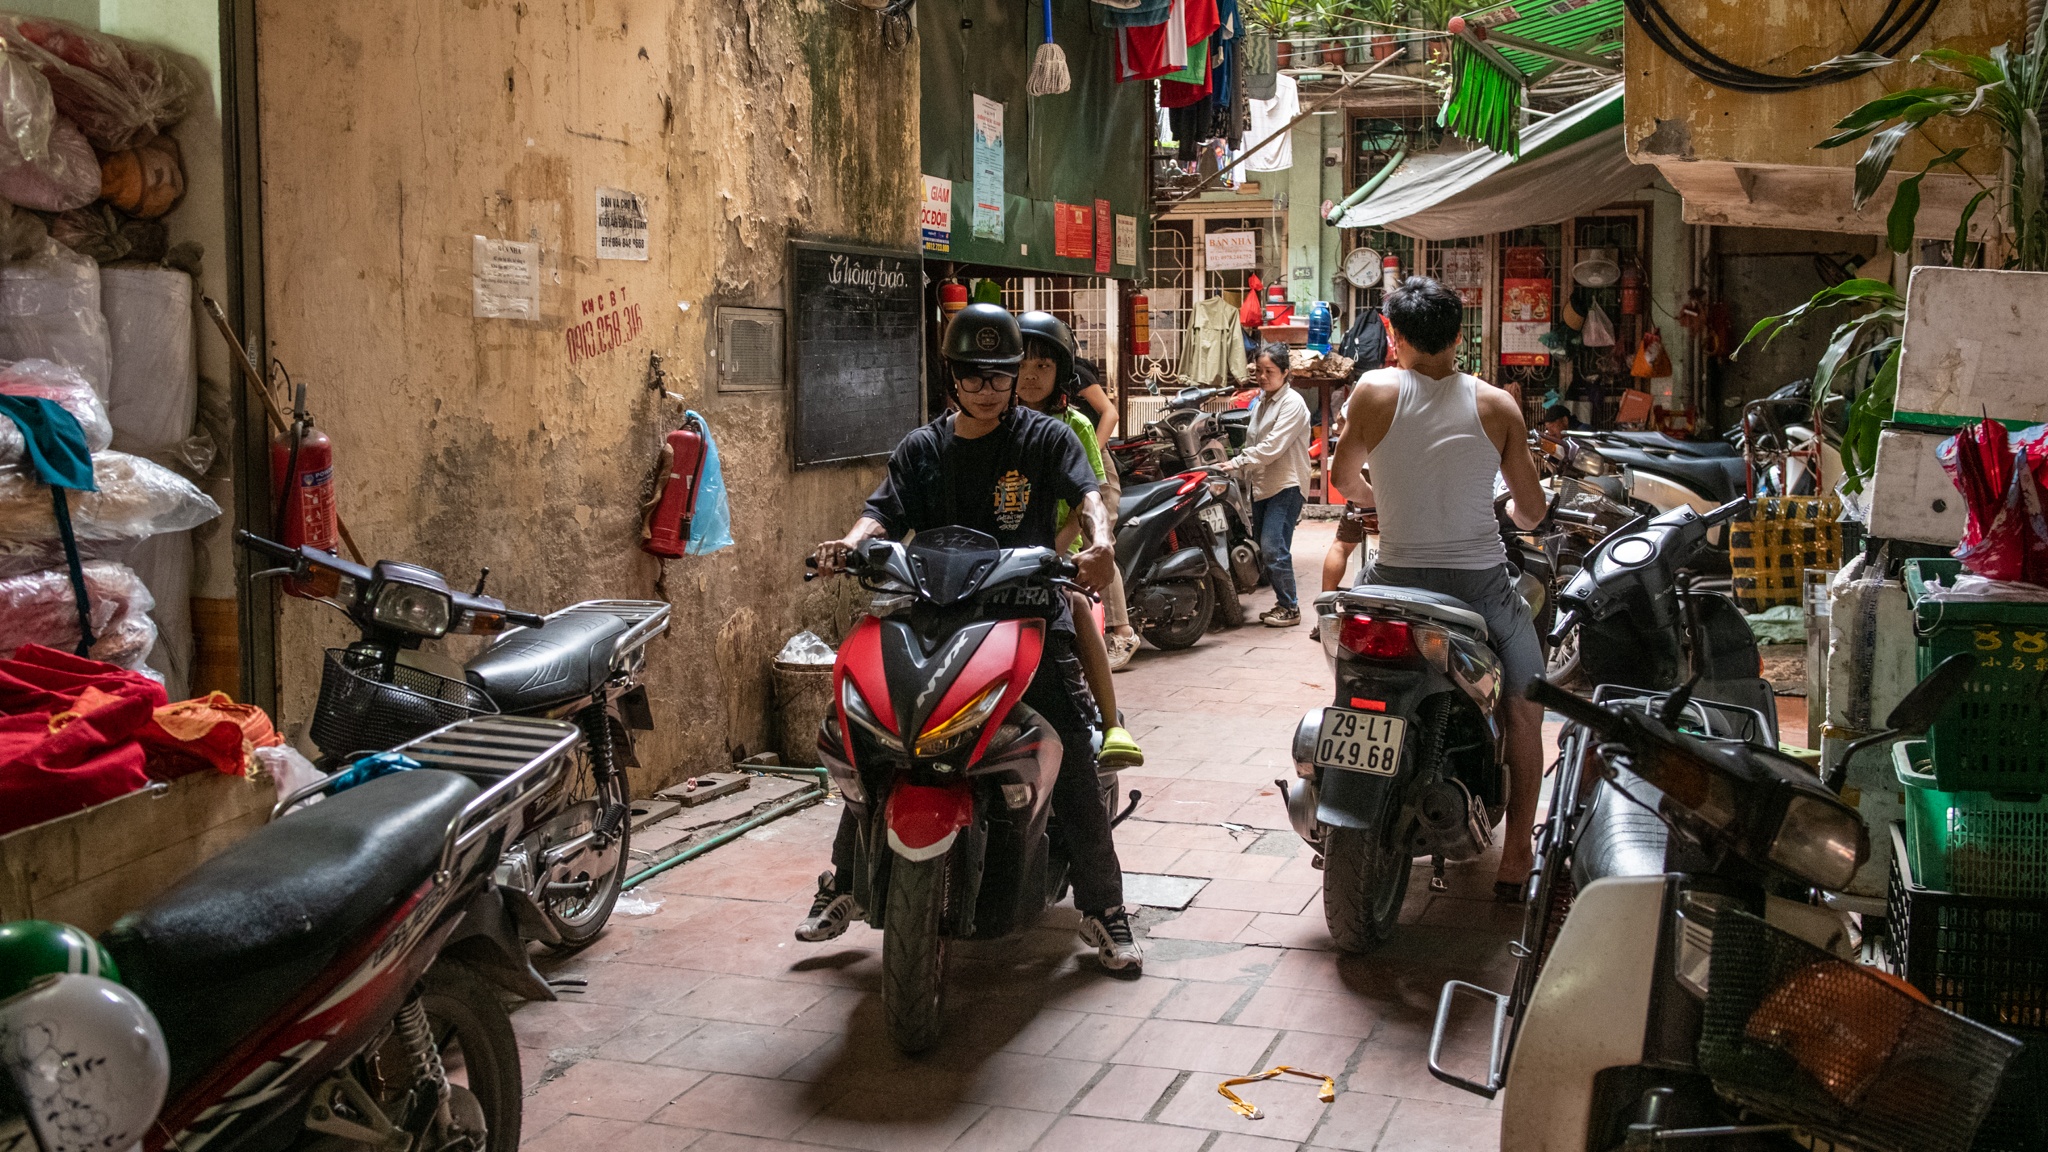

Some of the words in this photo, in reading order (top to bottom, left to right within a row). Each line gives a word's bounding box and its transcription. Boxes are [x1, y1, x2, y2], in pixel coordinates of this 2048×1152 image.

[829, 254, 876, 293] Thông
[609, 290, 616, 307] B
[620, 286, 625, 301] T
[1331, 712, 1392, 743] 29-L1
[1321, 738, 1394, 771] 049.68
